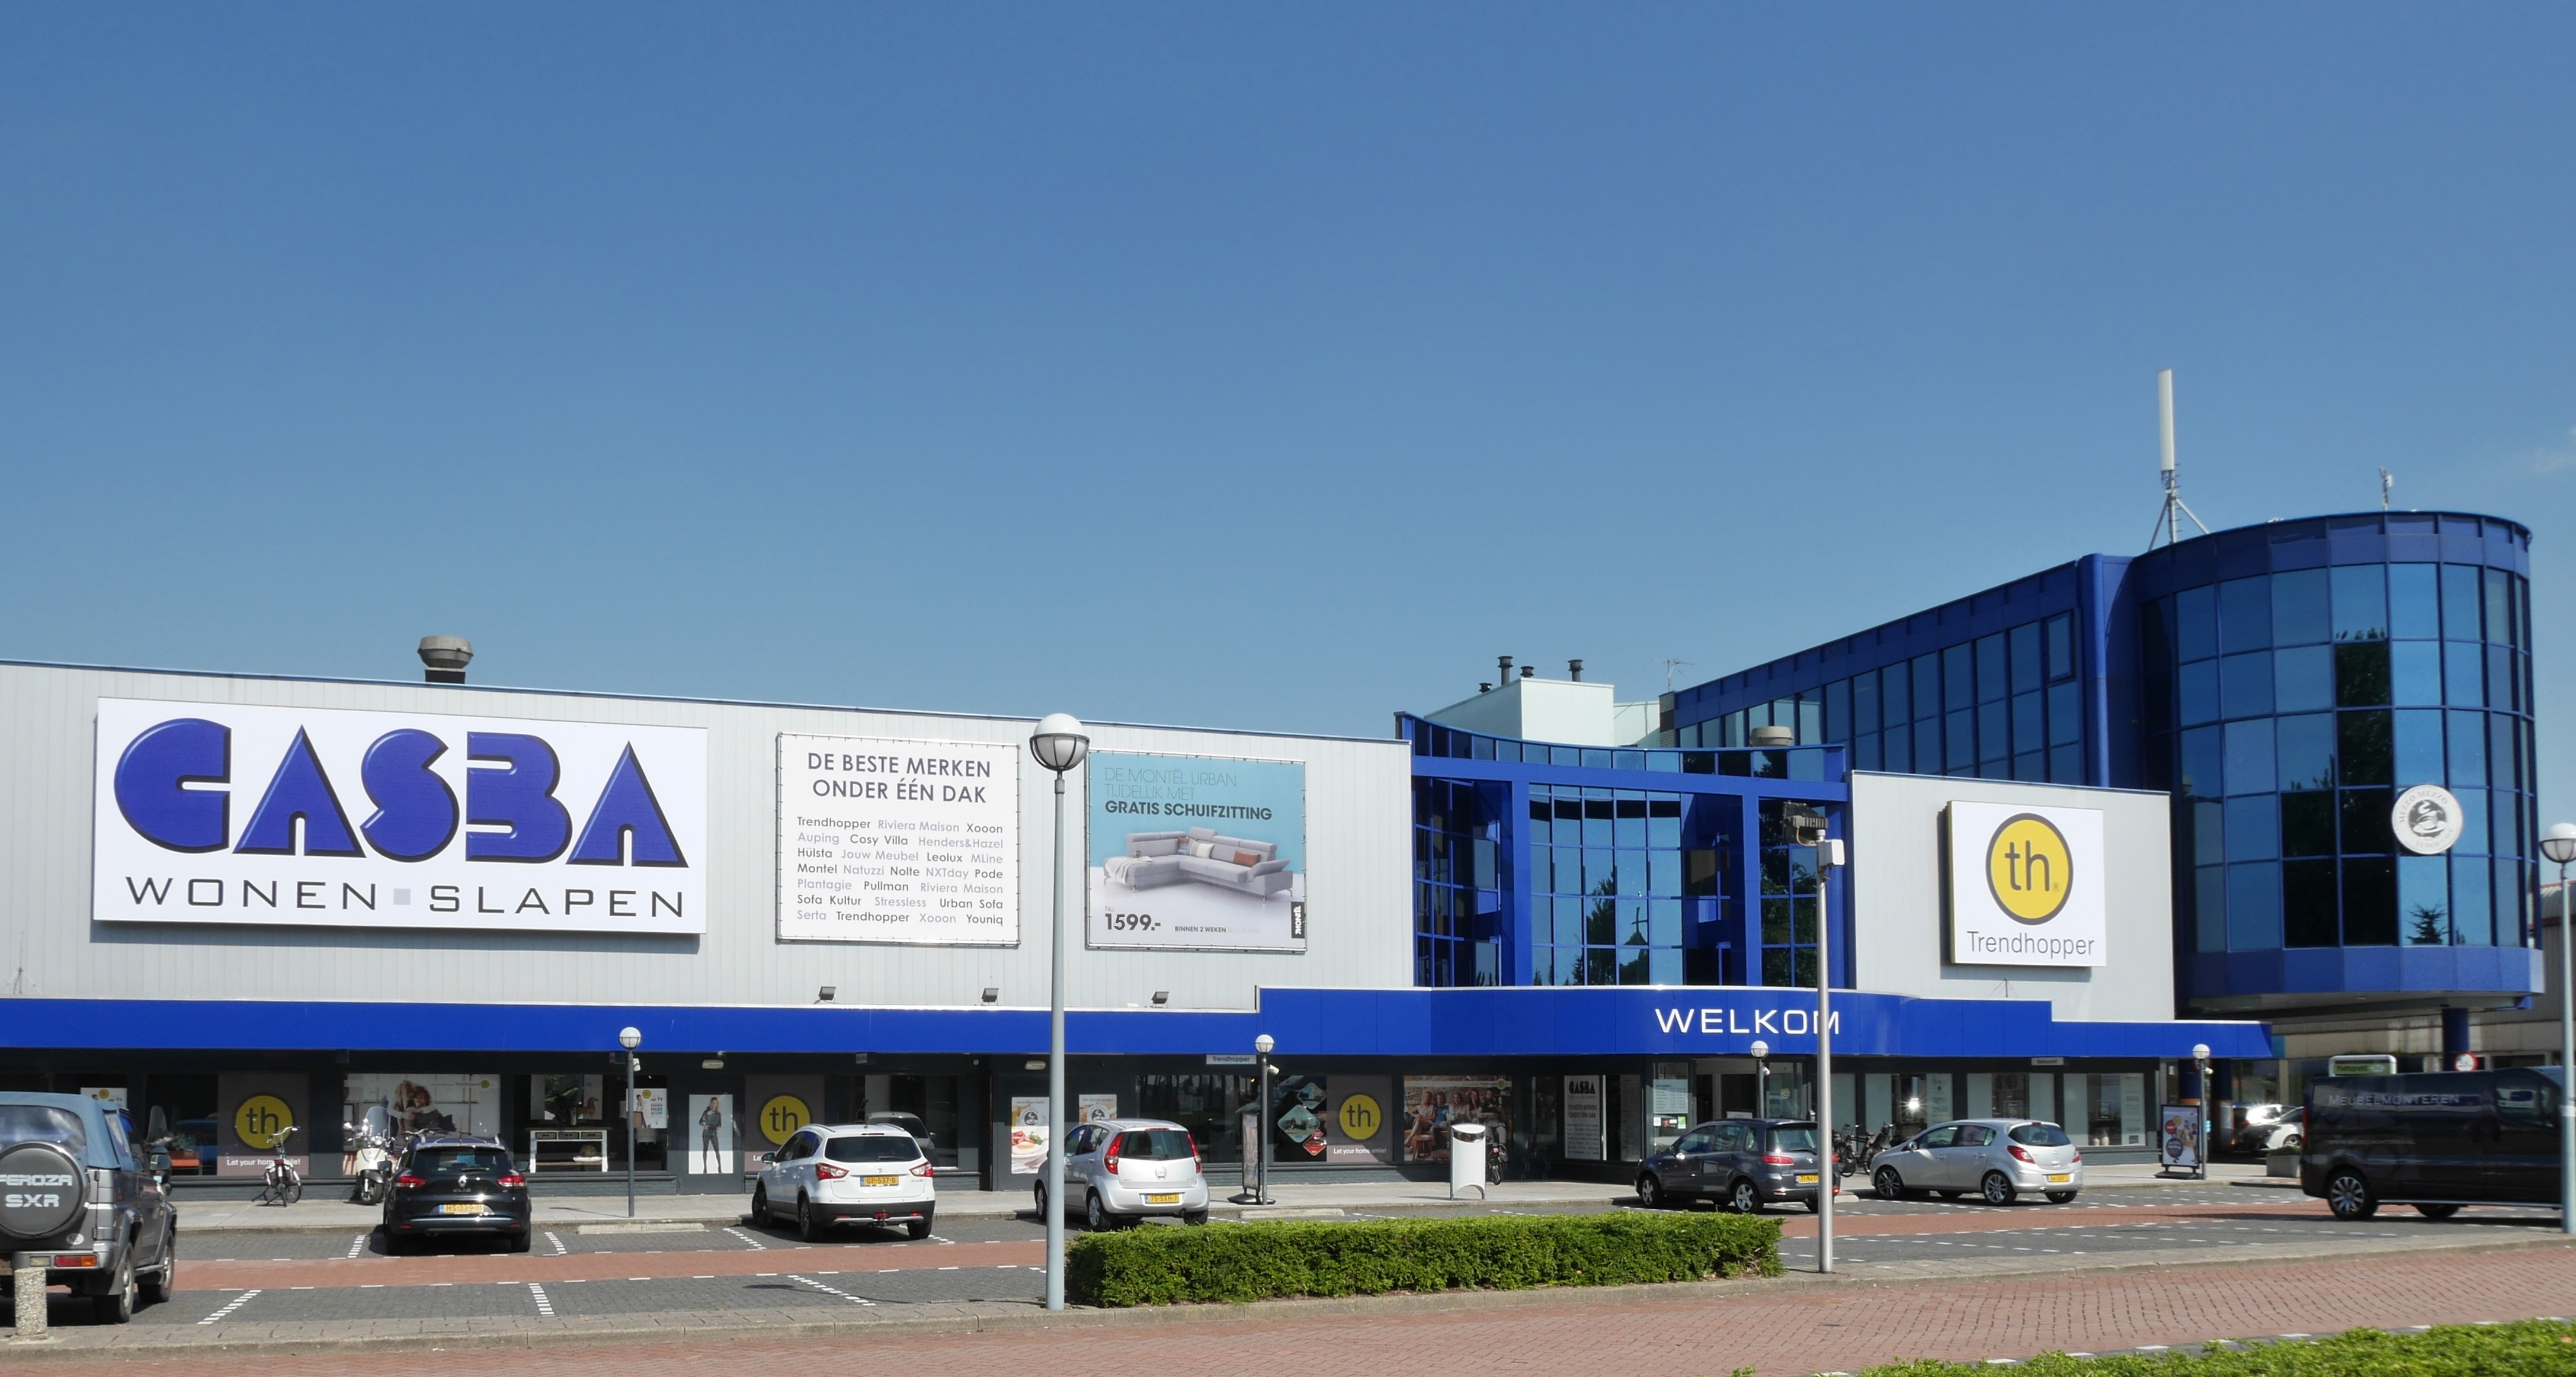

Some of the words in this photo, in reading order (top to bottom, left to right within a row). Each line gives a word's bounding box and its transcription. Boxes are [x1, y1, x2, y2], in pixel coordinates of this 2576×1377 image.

[808, 752, 834, 771] DE
[842, 754, 899, 773] BESTE
[906, 757, 990, 778] MERKEN
[1105, 768, 1123, 781] DE
[1191, 772, 1236, 787] URBAN
[113, 717, 689, 868] CASBA
[813, 779, 888, 799] ONDER
[896, 778, 934, 801] ÉÉN
[943, 785, 986, 803] DAK
[1105, 784, 1162, 800] TIJDELIJK
[1167, 787, 1196, 800] MET
[1105, 800, 1160, 815] GRATIS
[1164, 803, 1272, 820] SCHUIFZITTING
[797, 816, 871, 830] Trendhopper
[878, 820, 915, 830] Riviera
[919, 821, 959, 832] Maison
[966, 823, 1002, 833] Xooon
[797, 832, 840, 845] Auping
[850, 834, 879, 846] Cosy
[885, 835, 908, 845] Villa
[918, 836, 1003, 848] Henders&Hazel
[797, 848, 832, 858] Hülsta
[841, 849, 871, 859] Jouw
[875, 850, 918, 861] Meubel
[927, 852, 963, 862] Leolux
[971, 853, 1003, 864] MLine
[797, 864, 837, 874] Montel
[844, 865, 884, 875] Natuzzi
[890, 866, 920, 876] Nolte
[926, 868, 969, 880] NXTday
[975, 869, 1003, 878] Pode
[797, 879, 852, 891] Plantagie
[864, 881, 909, 891] Pullman
[921, 882, 957, 893] Riviera
[963, 884, 1003, 894] Maison
[125, 877, 375, 910] WONEN
[430, 885, 682, 917] SLAPEN
[797, 894, 822, 904] Sofa
[830, 895, 861, 905] Kultur
[874, 897, 927, 907] Stressless
[940, 898, 972, 908] Urban
[979, 899, 1003, 909] Sofa
[797, 910, 826, 920] Serta
[837, 911, 909, 923] Trendhopper
[919, 913, 956, 923] Xooon
[966, 914, 1003, 926] Youniq
[1967, 930, 2095, 959] Trendhopper
[1654, 1008, 1840, 1034] WELKOM
[1569, 1081, 1595, 1094] CASBA
[245, 1106, 279, 1134] th
[769, 1105, 798, 1132] th
[1347, 1103, 1371, 1128] th
[5, 1194, 59, 1208] SXR
